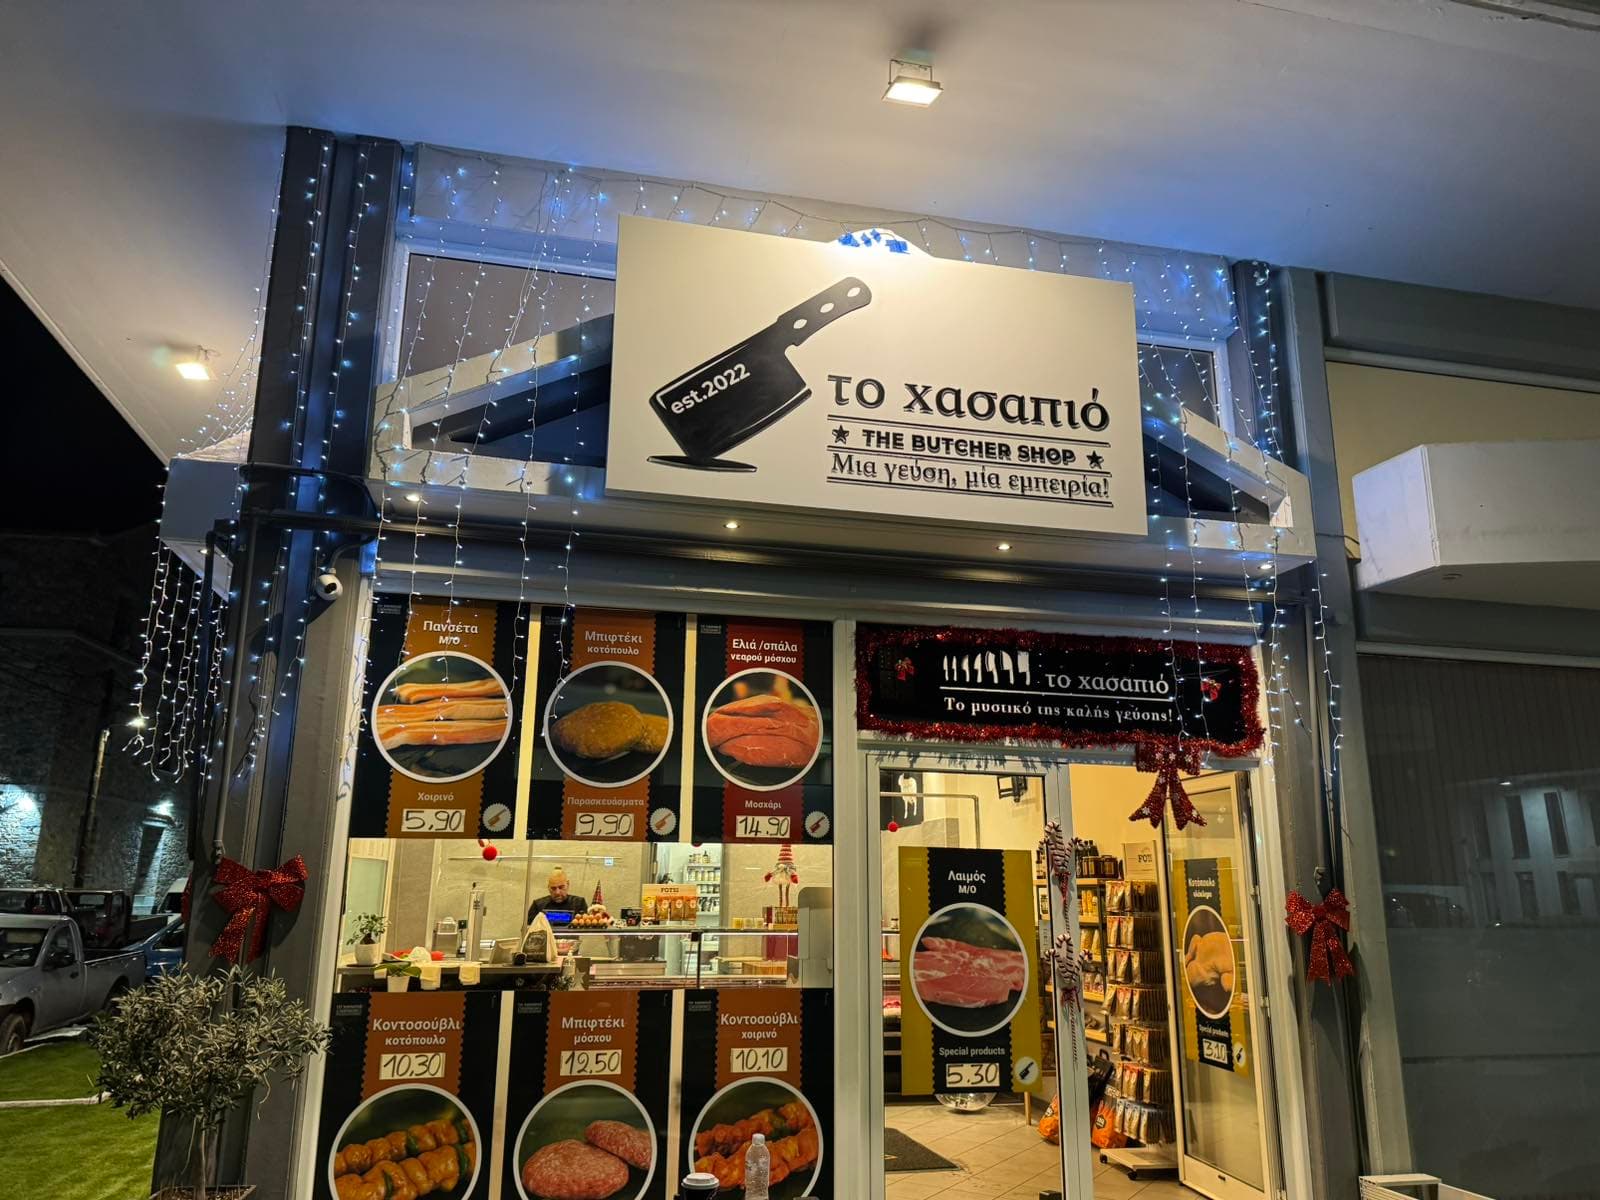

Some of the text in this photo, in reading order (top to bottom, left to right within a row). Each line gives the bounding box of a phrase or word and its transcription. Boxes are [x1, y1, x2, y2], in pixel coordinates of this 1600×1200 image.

[671, 363, 751, 414] est.2022
[828, 374, 1110, 432] το χασαπιό
[862, 429, 1076, 466] THE BUTCHER SHOP
[832, 453, 1110, 499] Μια γεύση, μία εμπειρία!
[423, 620, 478, 634] Πανσέτα
[585, 630, 643, 645] Μπιφτέκι
[732, 638, 757, 650] Ελιά
[587, 645, 640, 656] κοτόπουλο
[730, 652, 797, 664] νεαρού μόσχου
[1045, 673, 1170, 694] το χασαπιό
[943, 696, 966, 711] Το
[971, 700, 1032, 716] μυστικό
[1066, 703, 1110, 718] καλής
[1115, 707, 1173, 723] γεύσης!
[417, 792, 454, 802] Χοιρινό
[744, 799, 782, 810] Μοσχάρι
[947, 870, 987, 884] Λαιμός
[372, 1017, 461, 1033] Κοντοσούβλι
[561, 1016, 625, 1031] Μπιφτέκι
[720, 1012, 799, 1027] Κοντοσούβλι
[384, 1034, 446, 1046] κοτόπουλο
[573, 1032, 612, 1045] μόσχου
[741, 1028, 778, 1041] χοιρινό
[938, 1047, 1006, 1057] Special products
